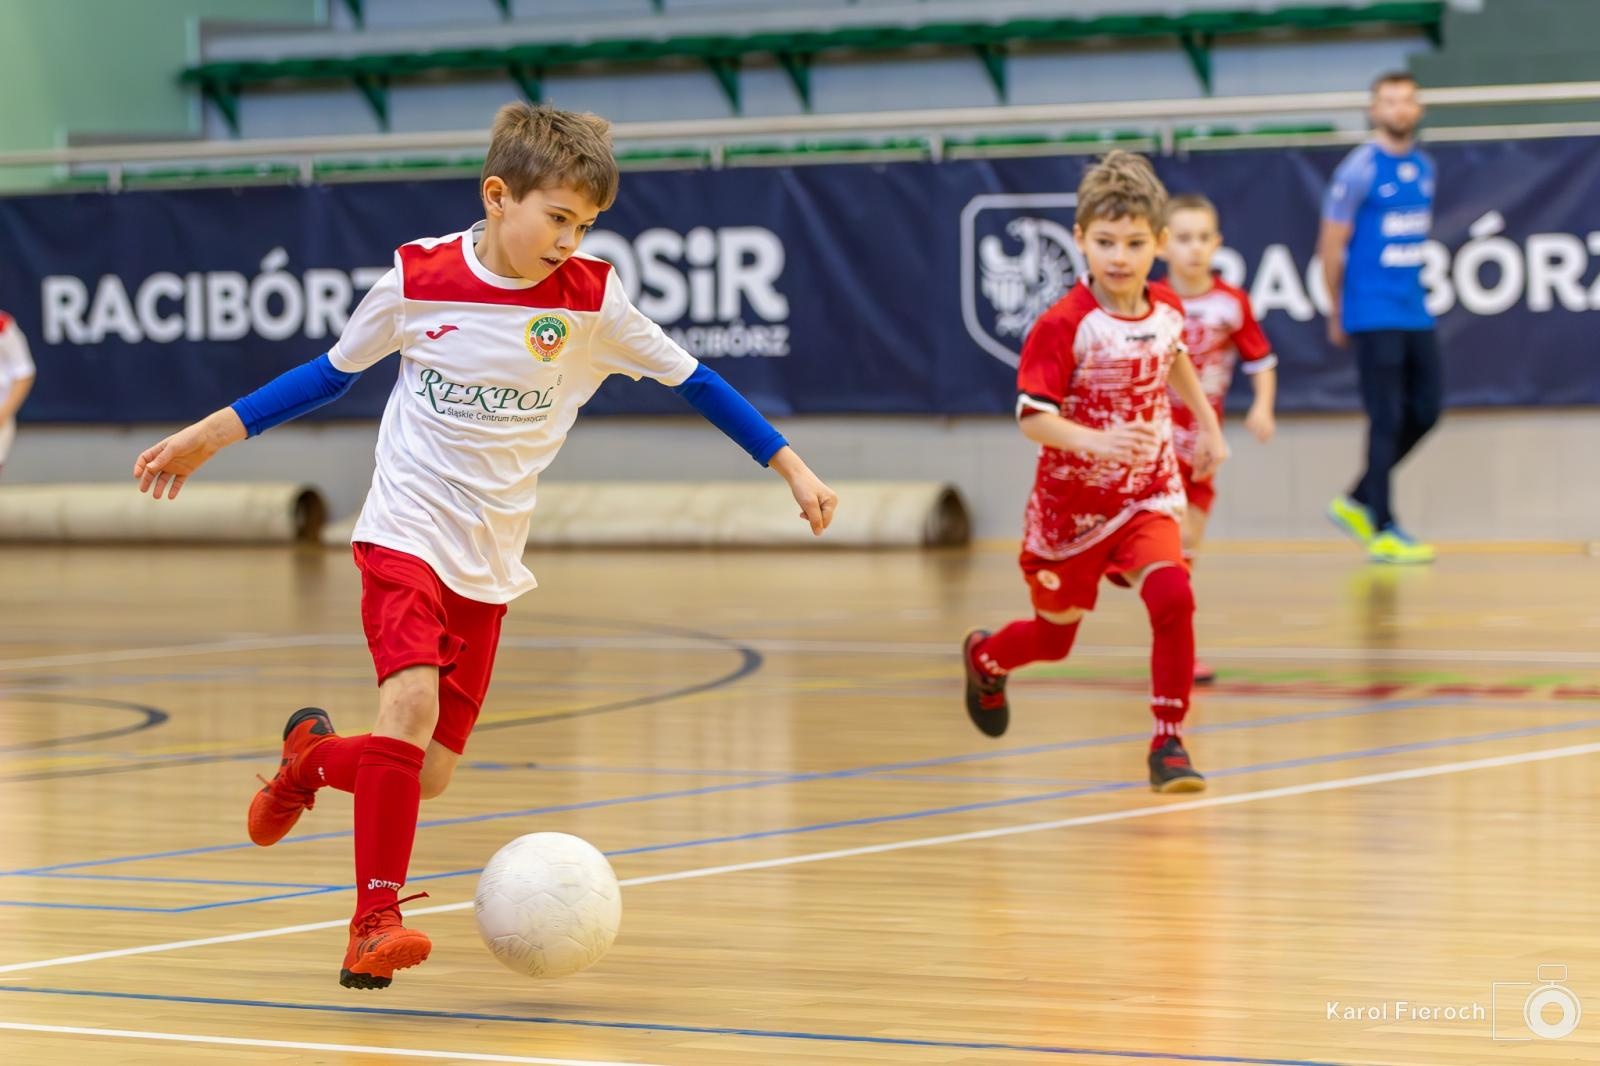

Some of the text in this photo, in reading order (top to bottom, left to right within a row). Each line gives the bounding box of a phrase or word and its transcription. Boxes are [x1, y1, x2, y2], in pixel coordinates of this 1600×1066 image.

[663, 318, 790, 357] ACIBÓRZ
[415, 368, 553, 414] REKPOL
[447, 407, 474, 419] Śląskie
[476, 412, 509, 422] Centrum
